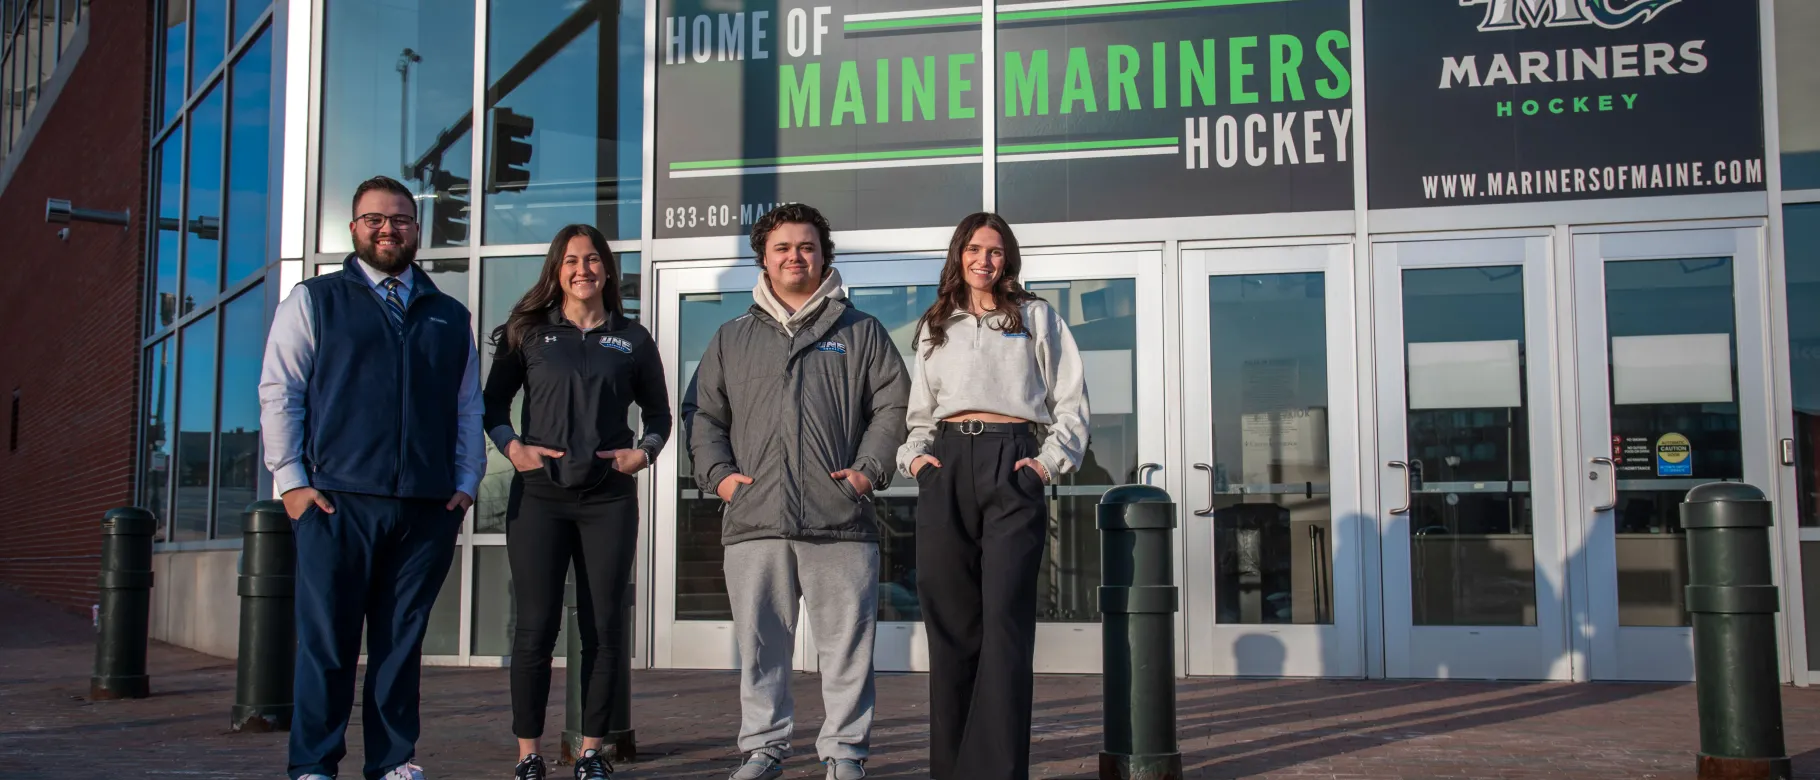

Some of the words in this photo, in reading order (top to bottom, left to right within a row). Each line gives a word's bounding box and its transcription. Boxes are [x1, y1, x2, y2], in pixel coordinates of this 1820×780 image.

[665, 10, 769, 65] HOME
[786, 6, 832, 58] OF
[778, 53, 976, 129] MAINE
[1004, 29, 1351, 117] MARINERS
[1438, 39, 1708, 89] MARINERS
[1496, 93, 1639, 117] HOCKEY
[1185, 108, 1352, 170] HOCKEY
[1422, 158, 1762, 199] WWW.MARINERSOFMAINE.COM
[665, 201, 797, 228] 833-GO-MA
